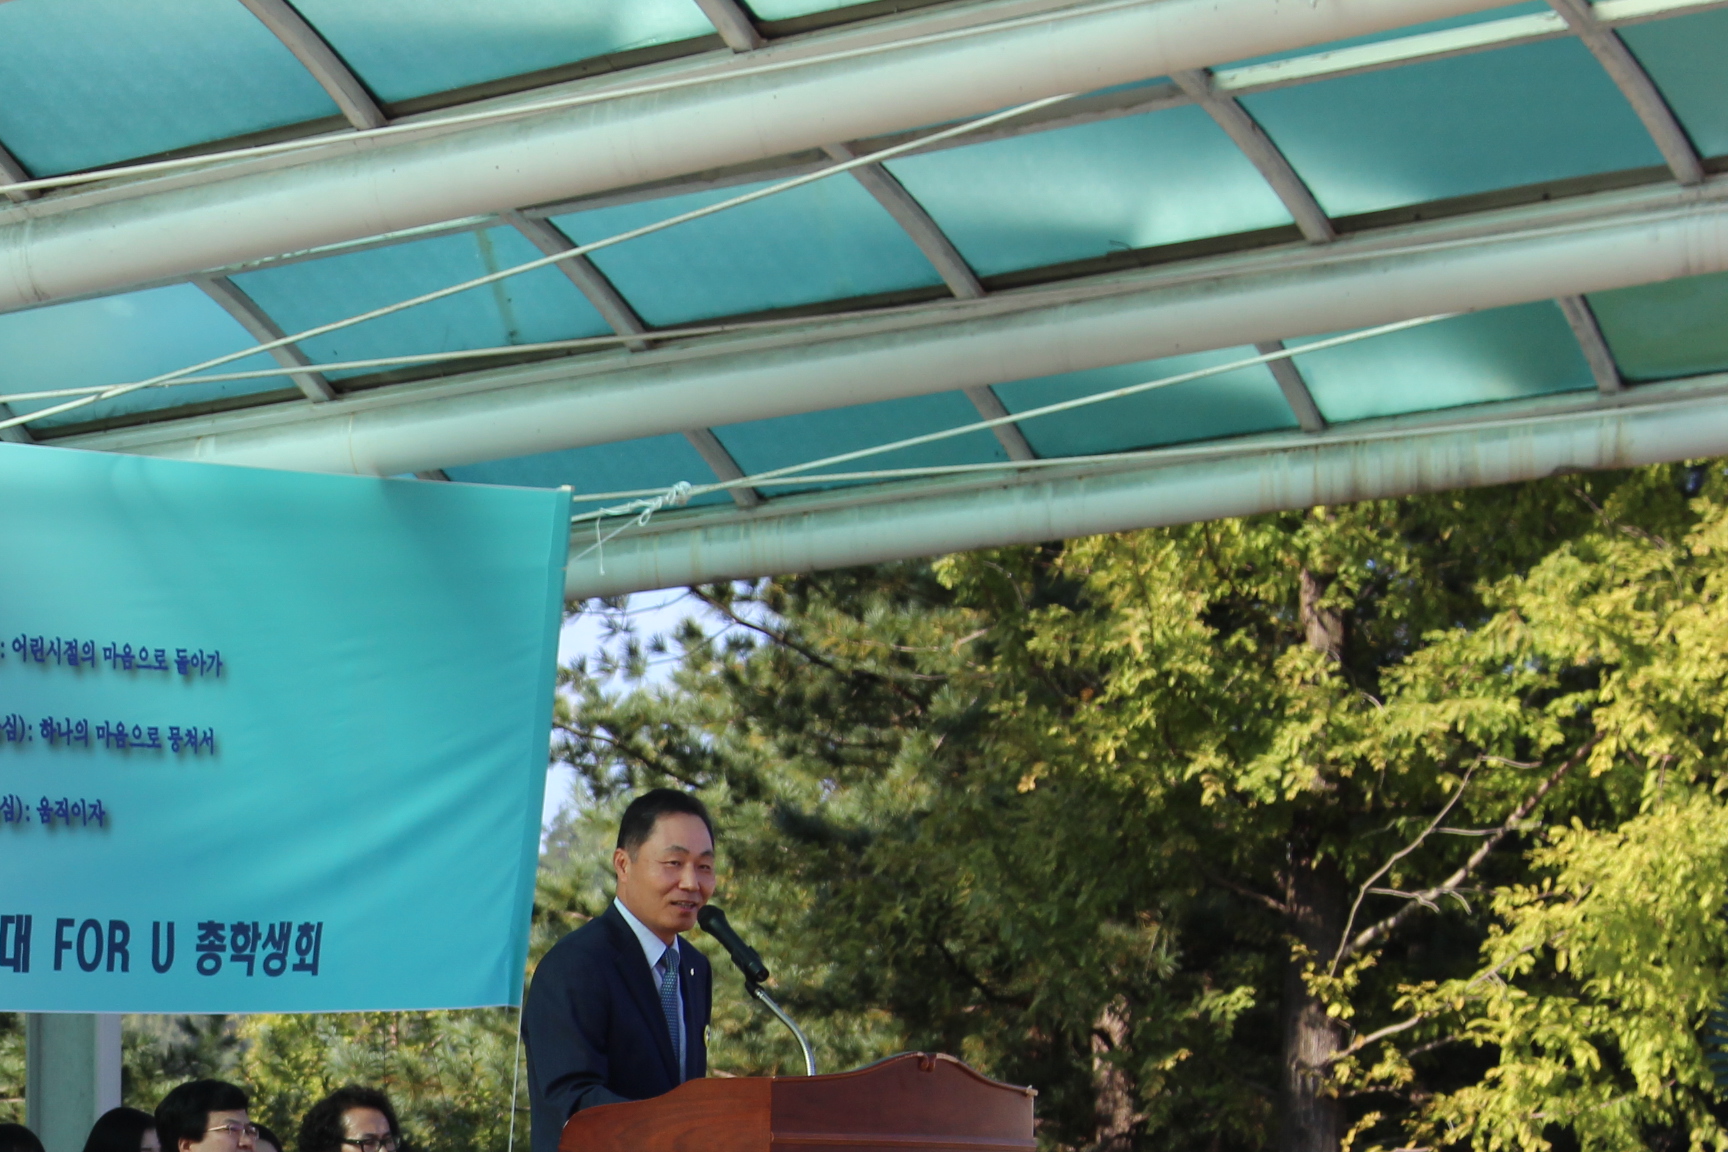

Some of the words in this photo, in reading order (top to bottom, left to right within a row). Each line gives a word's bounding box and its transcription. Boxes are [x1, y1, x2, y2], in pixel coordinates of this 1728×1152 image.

[11, 633, 96, 669] 어린시절의
[101, 641, 170, 671] 마음으로
[174, 647, 223, 678] 돌아가
[39, 715, 90, 748] 하나의
[95, 719, 163, 749] 마음으로
[166, 725, 215, 755] 뭉쳐서
[37, 795, 106, 828] 움직이자
[52, 917, 131, 973] FOR
[150, 920, 175, 974] U
[194, 919, 324, 977] 총학생회
